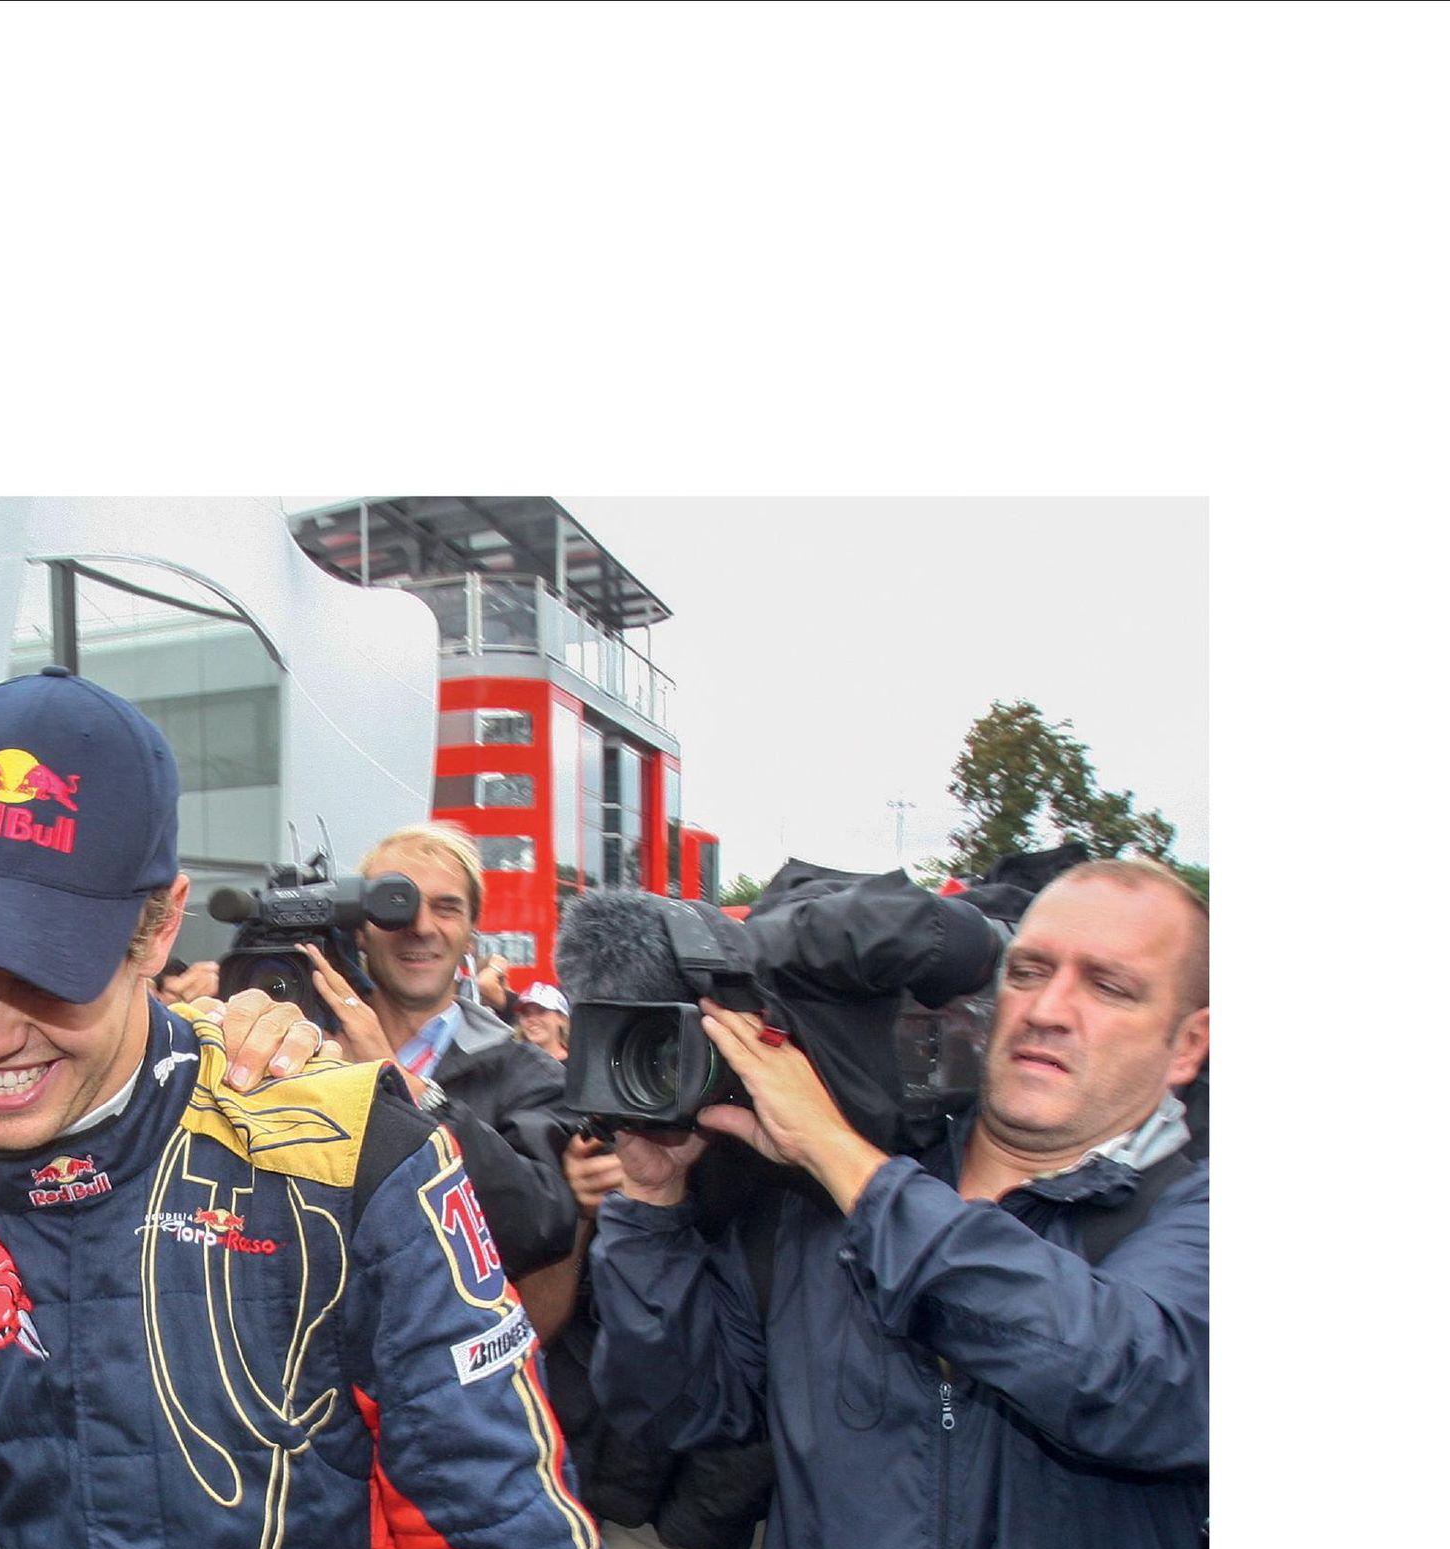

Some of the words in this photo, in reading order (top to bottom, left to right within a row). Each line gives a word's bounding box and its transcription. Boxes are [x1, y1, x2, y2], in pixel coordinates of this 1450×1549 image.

[4, 806, 76, 854] Bull
[29, 1183, 73, 1207] Red
[69, 1172, 113, 1202] Bull
